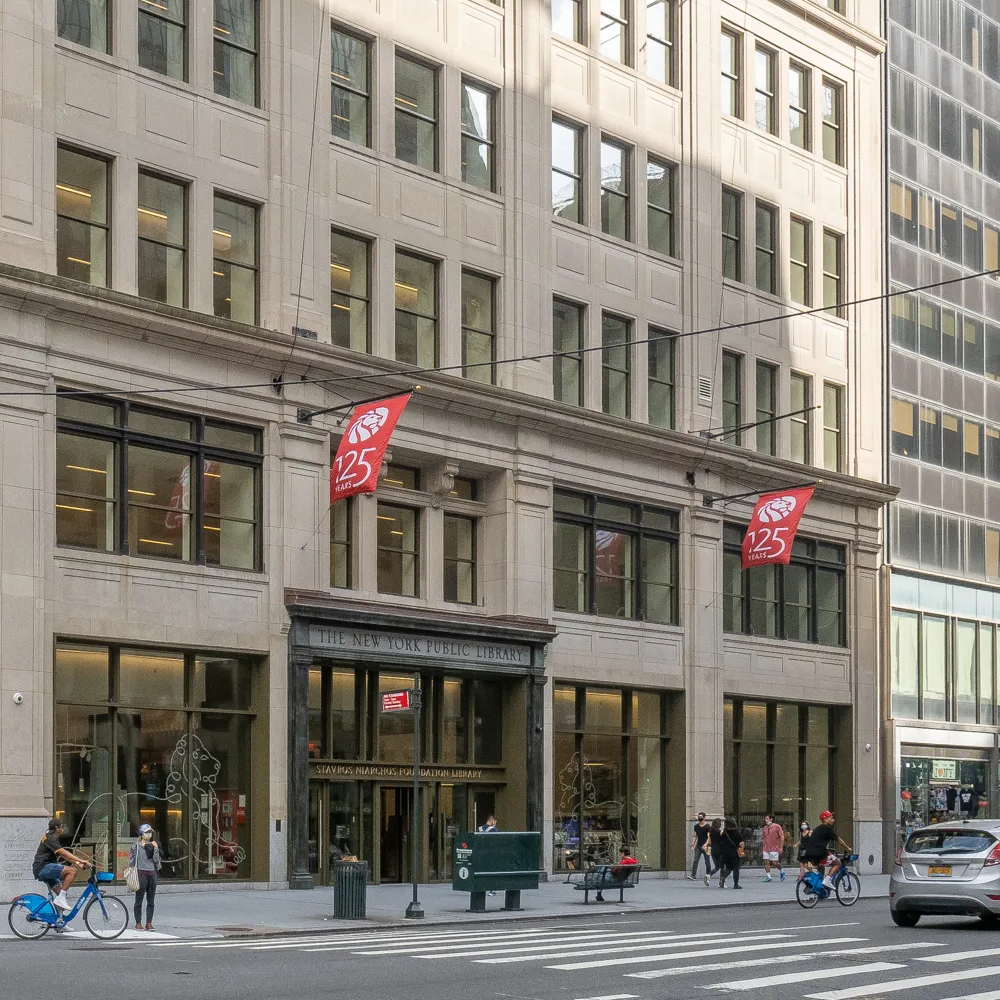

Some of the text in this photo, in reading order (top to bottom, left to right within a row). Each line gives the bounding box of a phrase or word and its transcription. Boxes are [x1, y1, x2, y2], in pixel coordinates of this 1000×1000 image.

[335, 447, 376, 488] 125
[335, 480, 352, 492] YEARS
[748, 527, 789, 558] 125
[748, 552, 767, 561] YEARS
[318, 629, 523, 661] THE NEW YORK PUBLIC LIBRARY
[316, 764, 482, 779] STAVROS NIARCHOS FOUDATION LIBRARY
